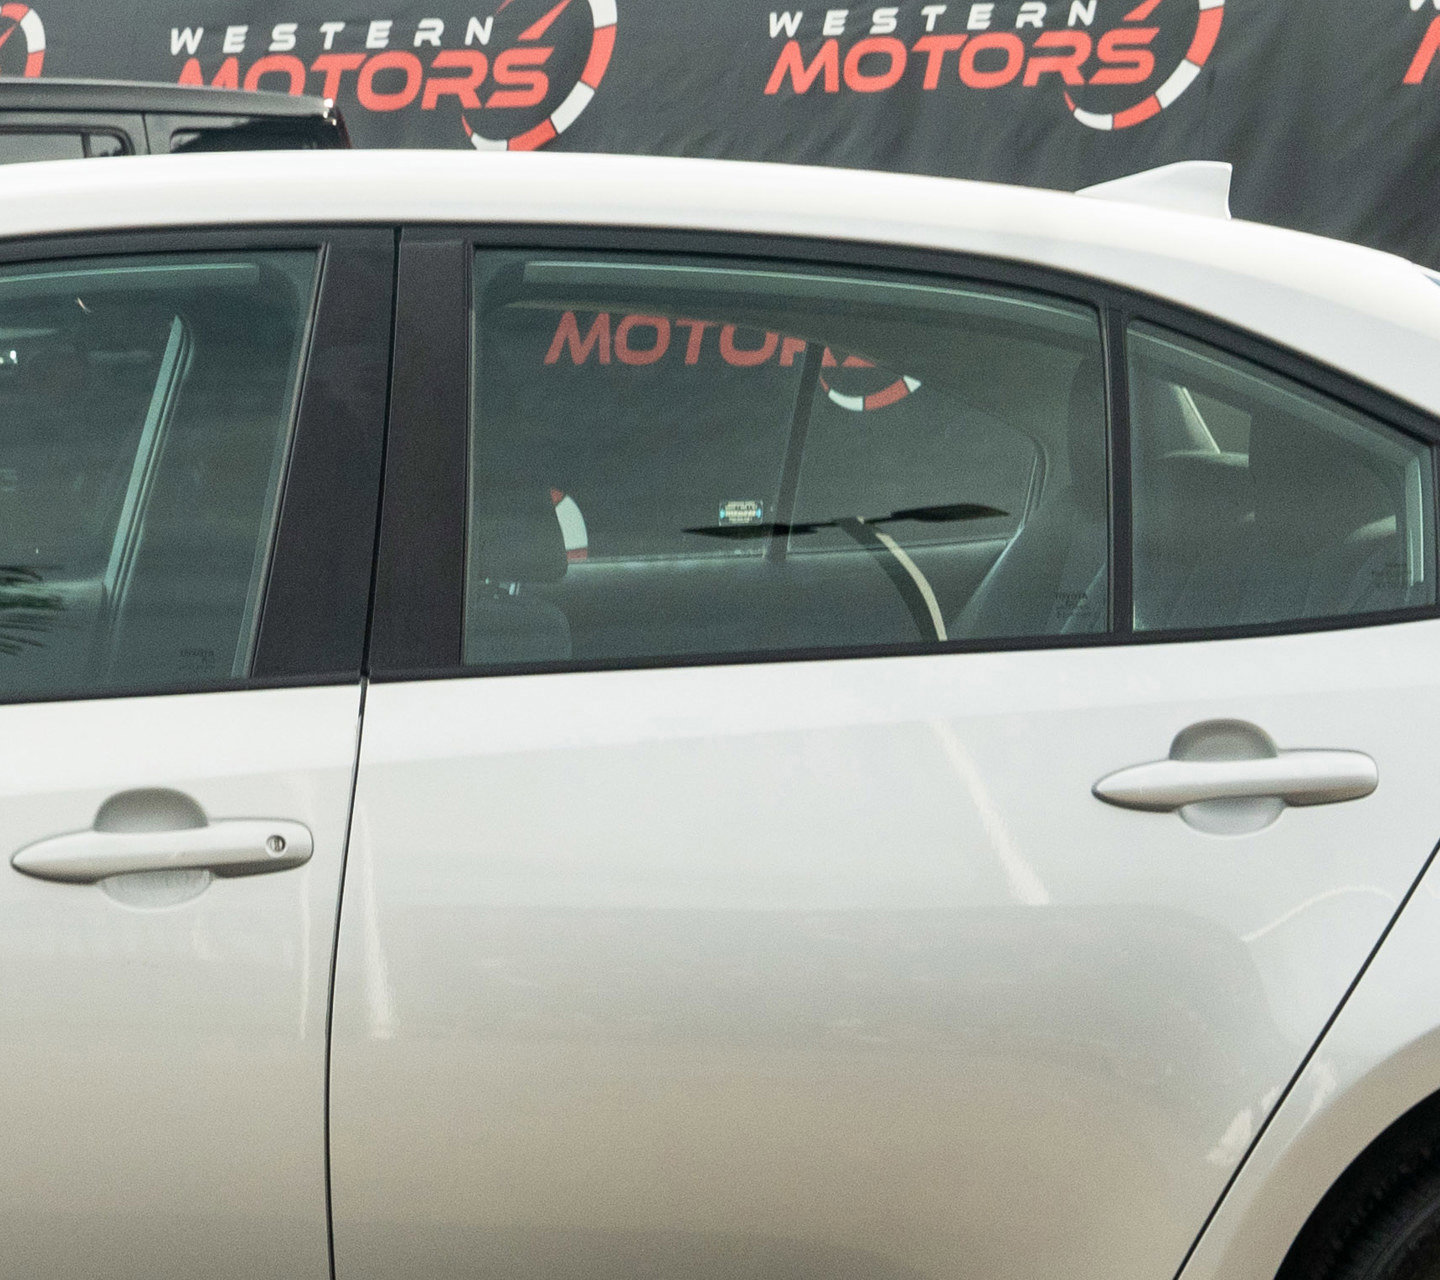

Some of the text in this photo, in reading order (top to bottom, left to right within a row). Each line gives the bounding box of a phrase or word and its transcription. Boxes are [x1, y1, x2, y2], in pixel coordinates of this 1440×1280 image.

[170, 16, 494, 56] WESTERN
[769, 0, 1098, 38] WESTERN
[763, 27, 1160, 95] MOTORS
